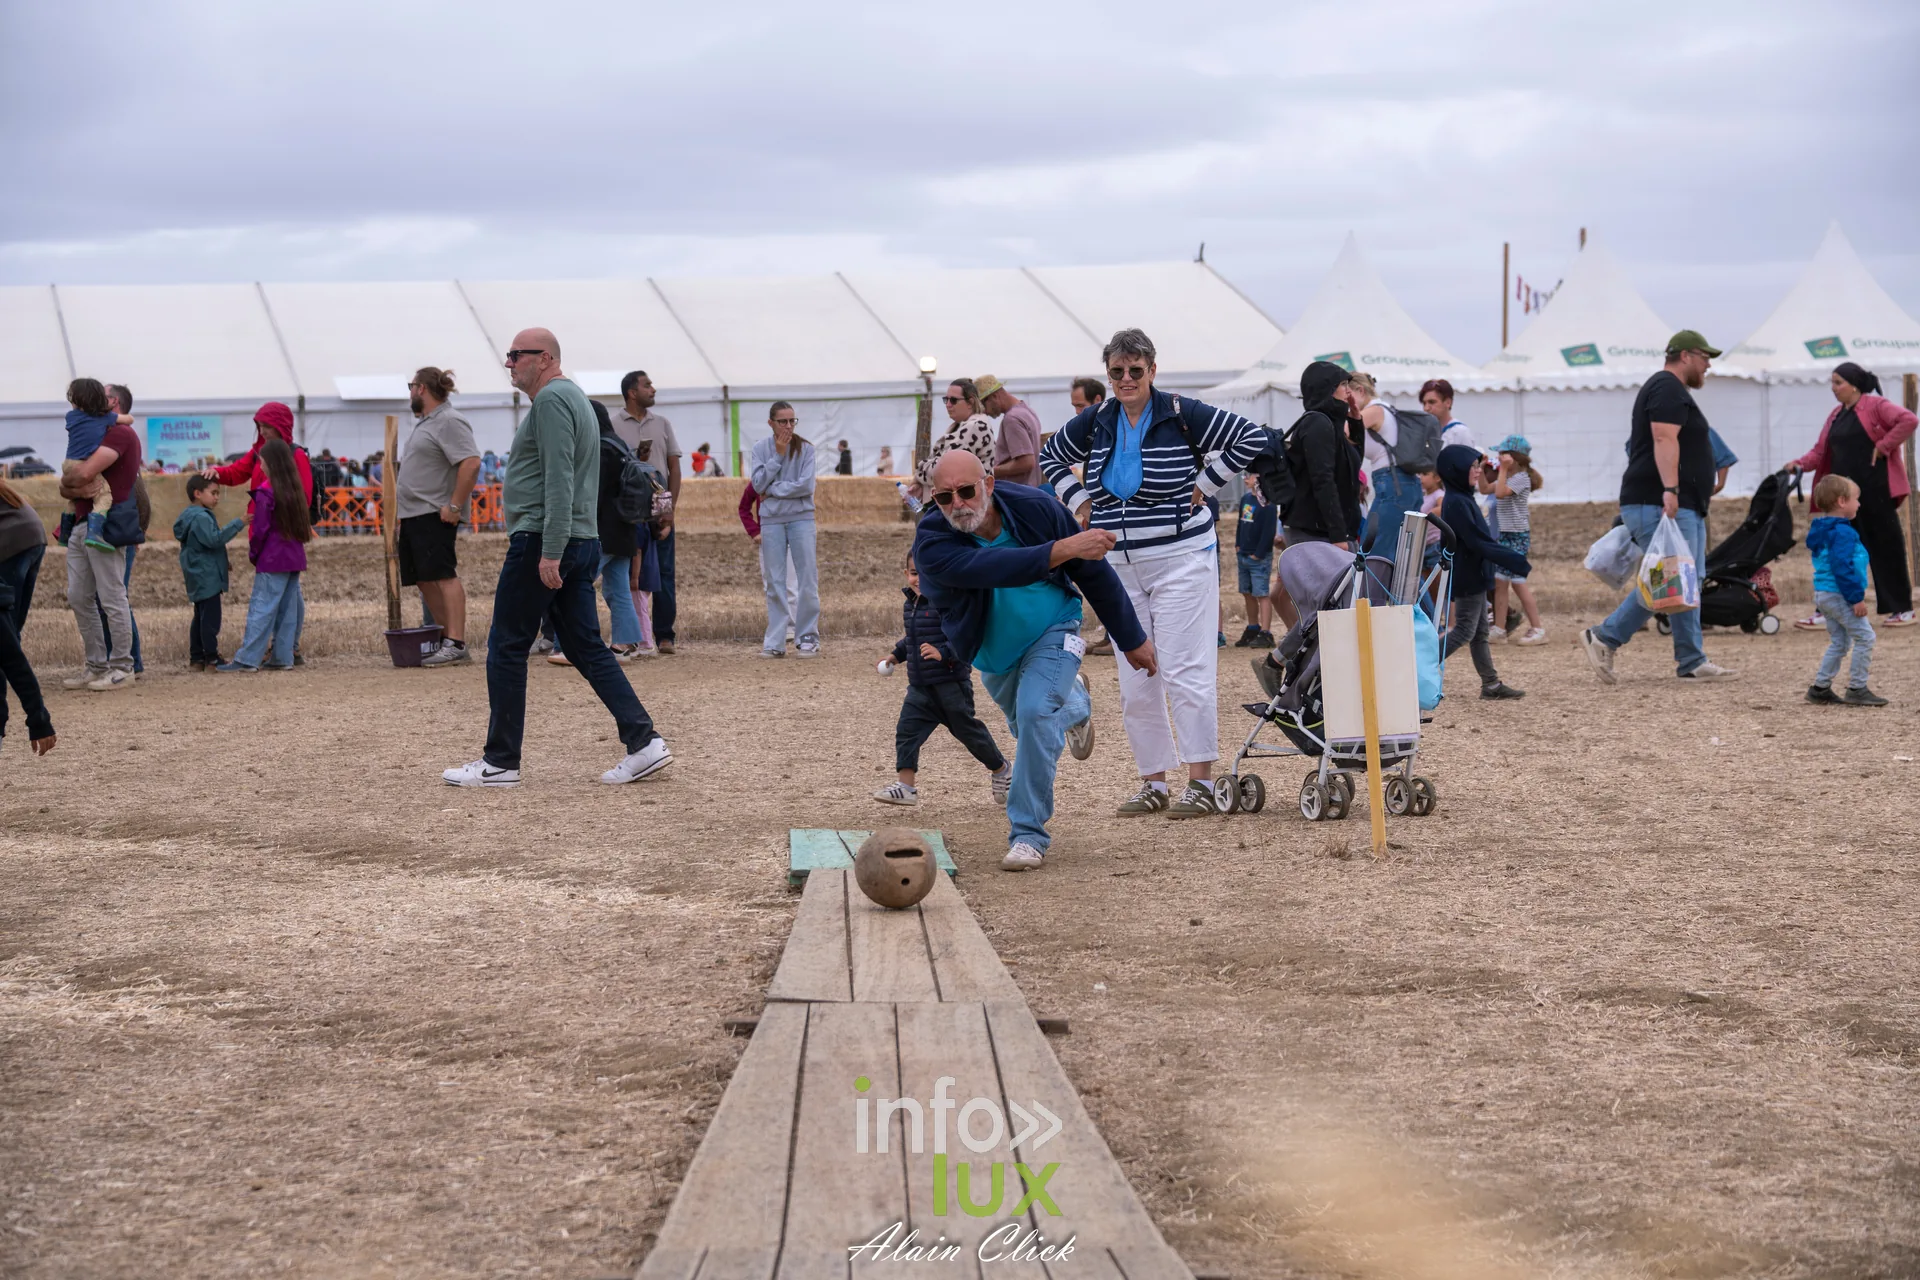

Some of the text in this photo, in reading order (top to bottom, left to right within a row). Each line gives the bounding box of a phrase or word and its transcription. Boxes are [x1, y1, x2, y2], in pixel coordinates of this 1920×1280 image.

[1360, 354, 1450, 367] Groupama
[162, 421, 203, 431] PLATEAU
[160, 431, 210, 441] MOSELLAN
